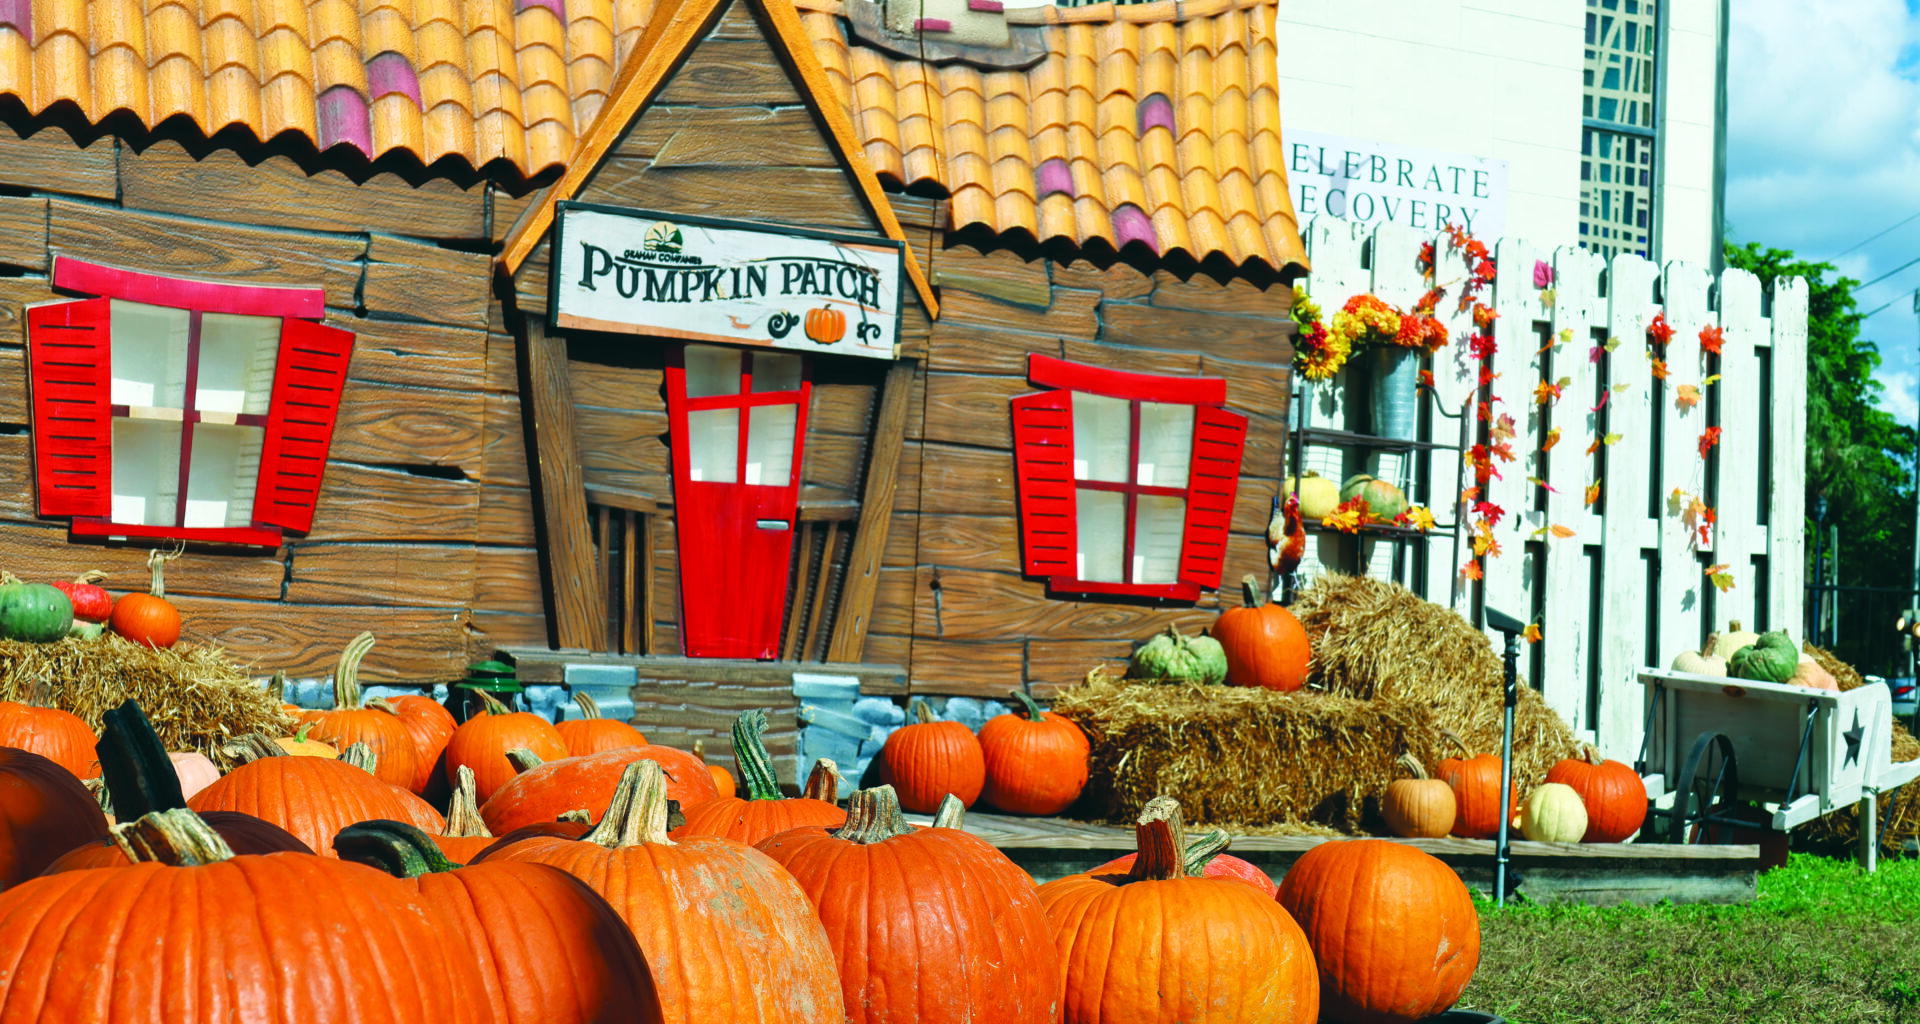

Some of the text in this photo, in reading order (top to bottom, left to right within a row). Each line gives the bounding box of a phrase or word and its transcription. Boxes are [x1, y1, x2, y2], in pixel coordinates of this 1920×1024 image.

[1291, 143, 1490, 199] ELEBRATE
[1299, 184, 1479, 235] ECOVERY
[578, 240, 881, 309] PUMPKIN PATCH
[623, 249, 703, 265] GRAHAM COMPANIES
